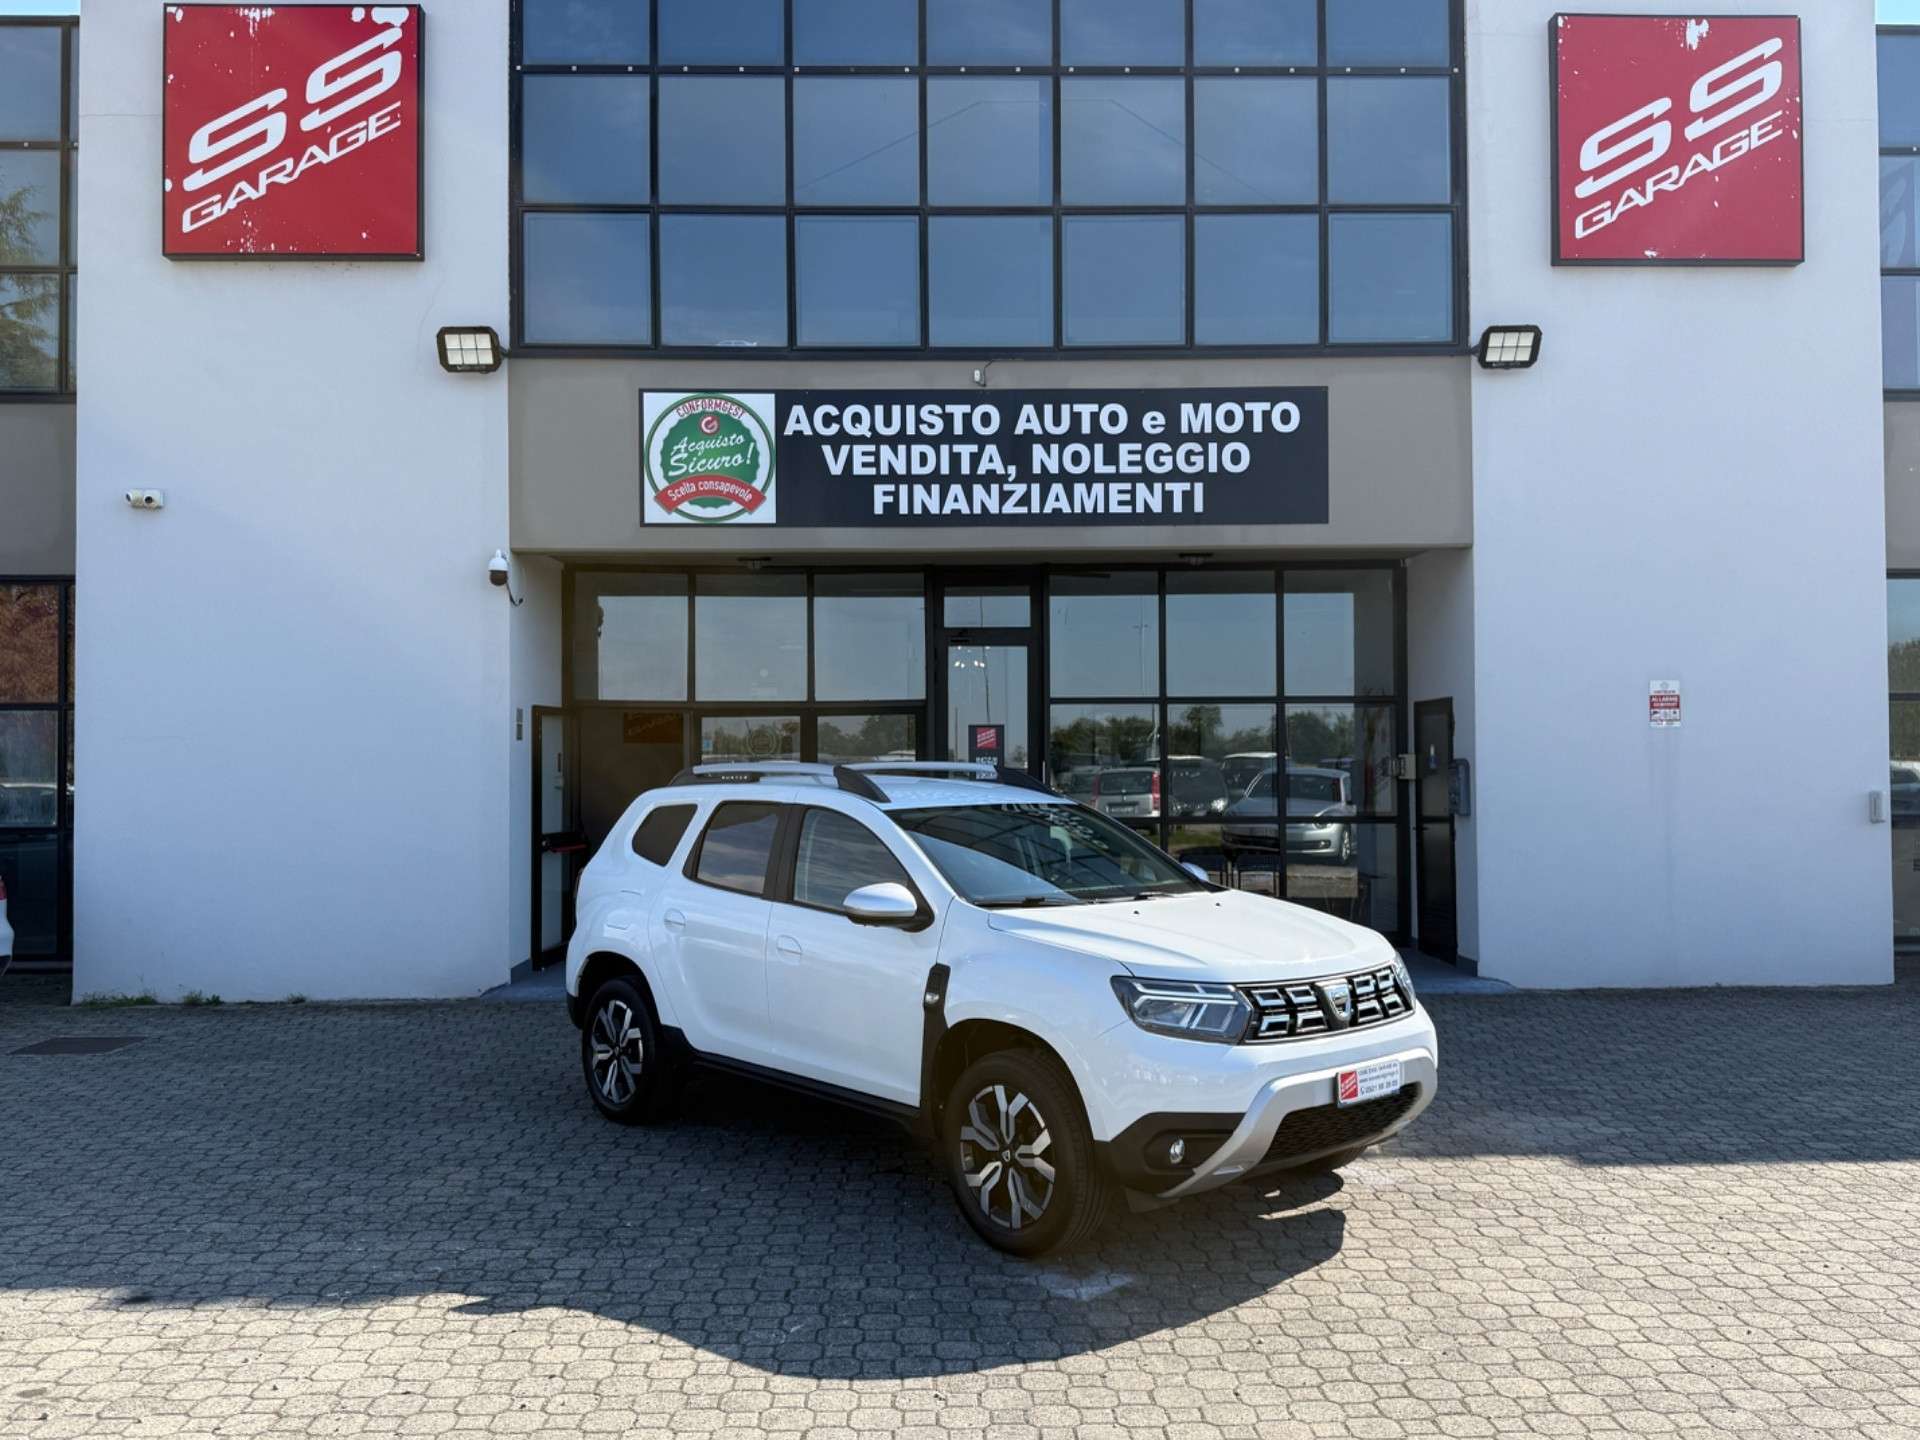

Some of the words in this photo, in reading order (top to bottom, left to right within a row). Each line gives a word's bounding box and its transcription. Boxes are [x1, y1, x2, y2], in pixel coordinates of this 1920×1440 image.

[182, 100, 402, 234] GARAGE
[1574, 110, 1784, 239] GARAGE
[783, 403, 1001, 438] ACQUISTO
[1014, 402, 1129, 436] AUTO
[1141, 410, 1167, 435] e
[1180, 401, 1301, 434] MOTO
[668, 442, 755, 477] Sicuro!
[670, 433, 745, 456] Acquisto
[821, 443, 1017, 482] VENDITA,
[1032, 441, 1251, 475] NOLEGGIO
[698, 480, 753, 502] consapevole
[873, 481, 1204, 515] FINANZIAMENTI
